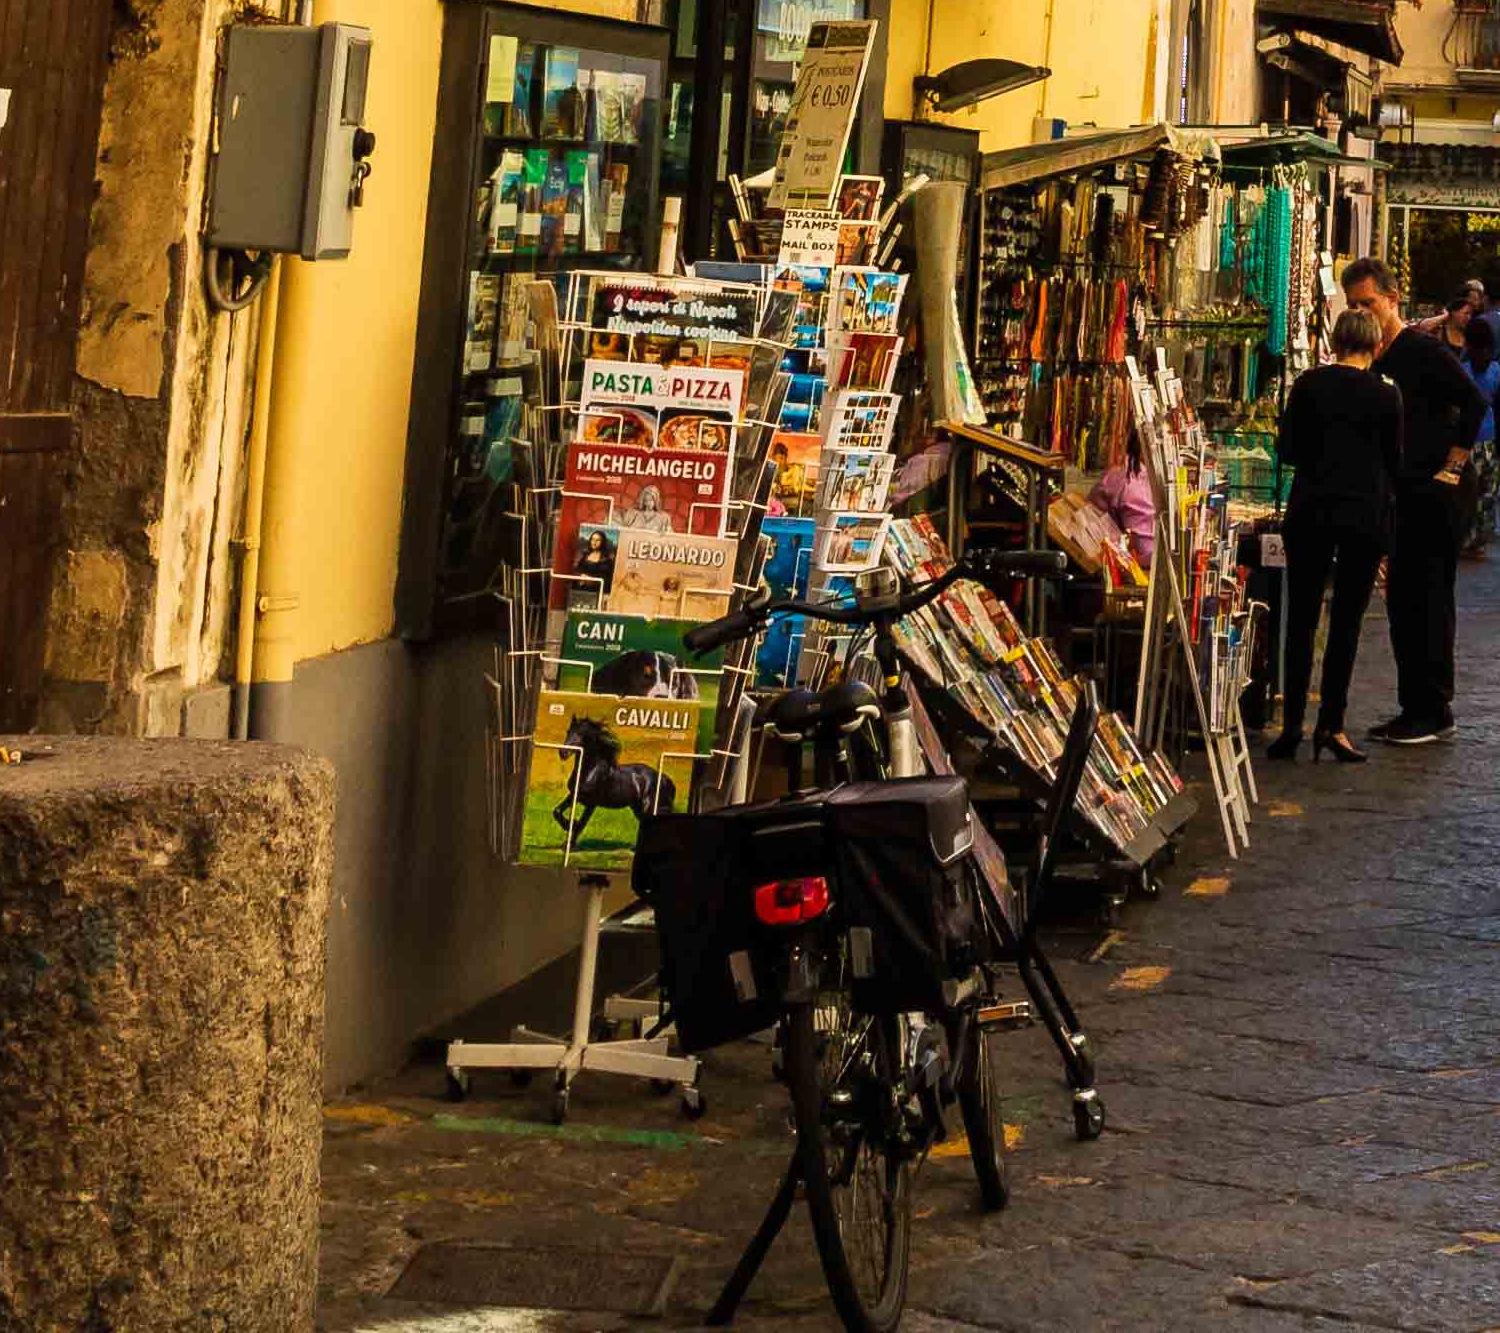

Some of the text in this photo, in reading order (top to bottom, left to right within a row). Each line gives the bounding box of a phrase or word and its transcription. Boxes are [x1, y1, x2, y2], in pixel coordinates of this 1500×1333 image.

[785, 219, 839, 232] STAMPS
[787, 210, 841, 221] TRACEABLE
[781, 240, 836, 251] MAIL BOX
[625, 298, 671, 316] sapori
[672, 299, 688, 315] di
[689, 300, 738, 322] Napoli
[591, 371, 654, 396] PASTA
[671, 377, 733, 402] PIZZA
[576, 452, 717, 481] MICHELANGELO
[627, 539, 726, 567] LEONARDO
[576, 619, 625, 642] CANI
[614, 706, 691, 731] CAVALLI
